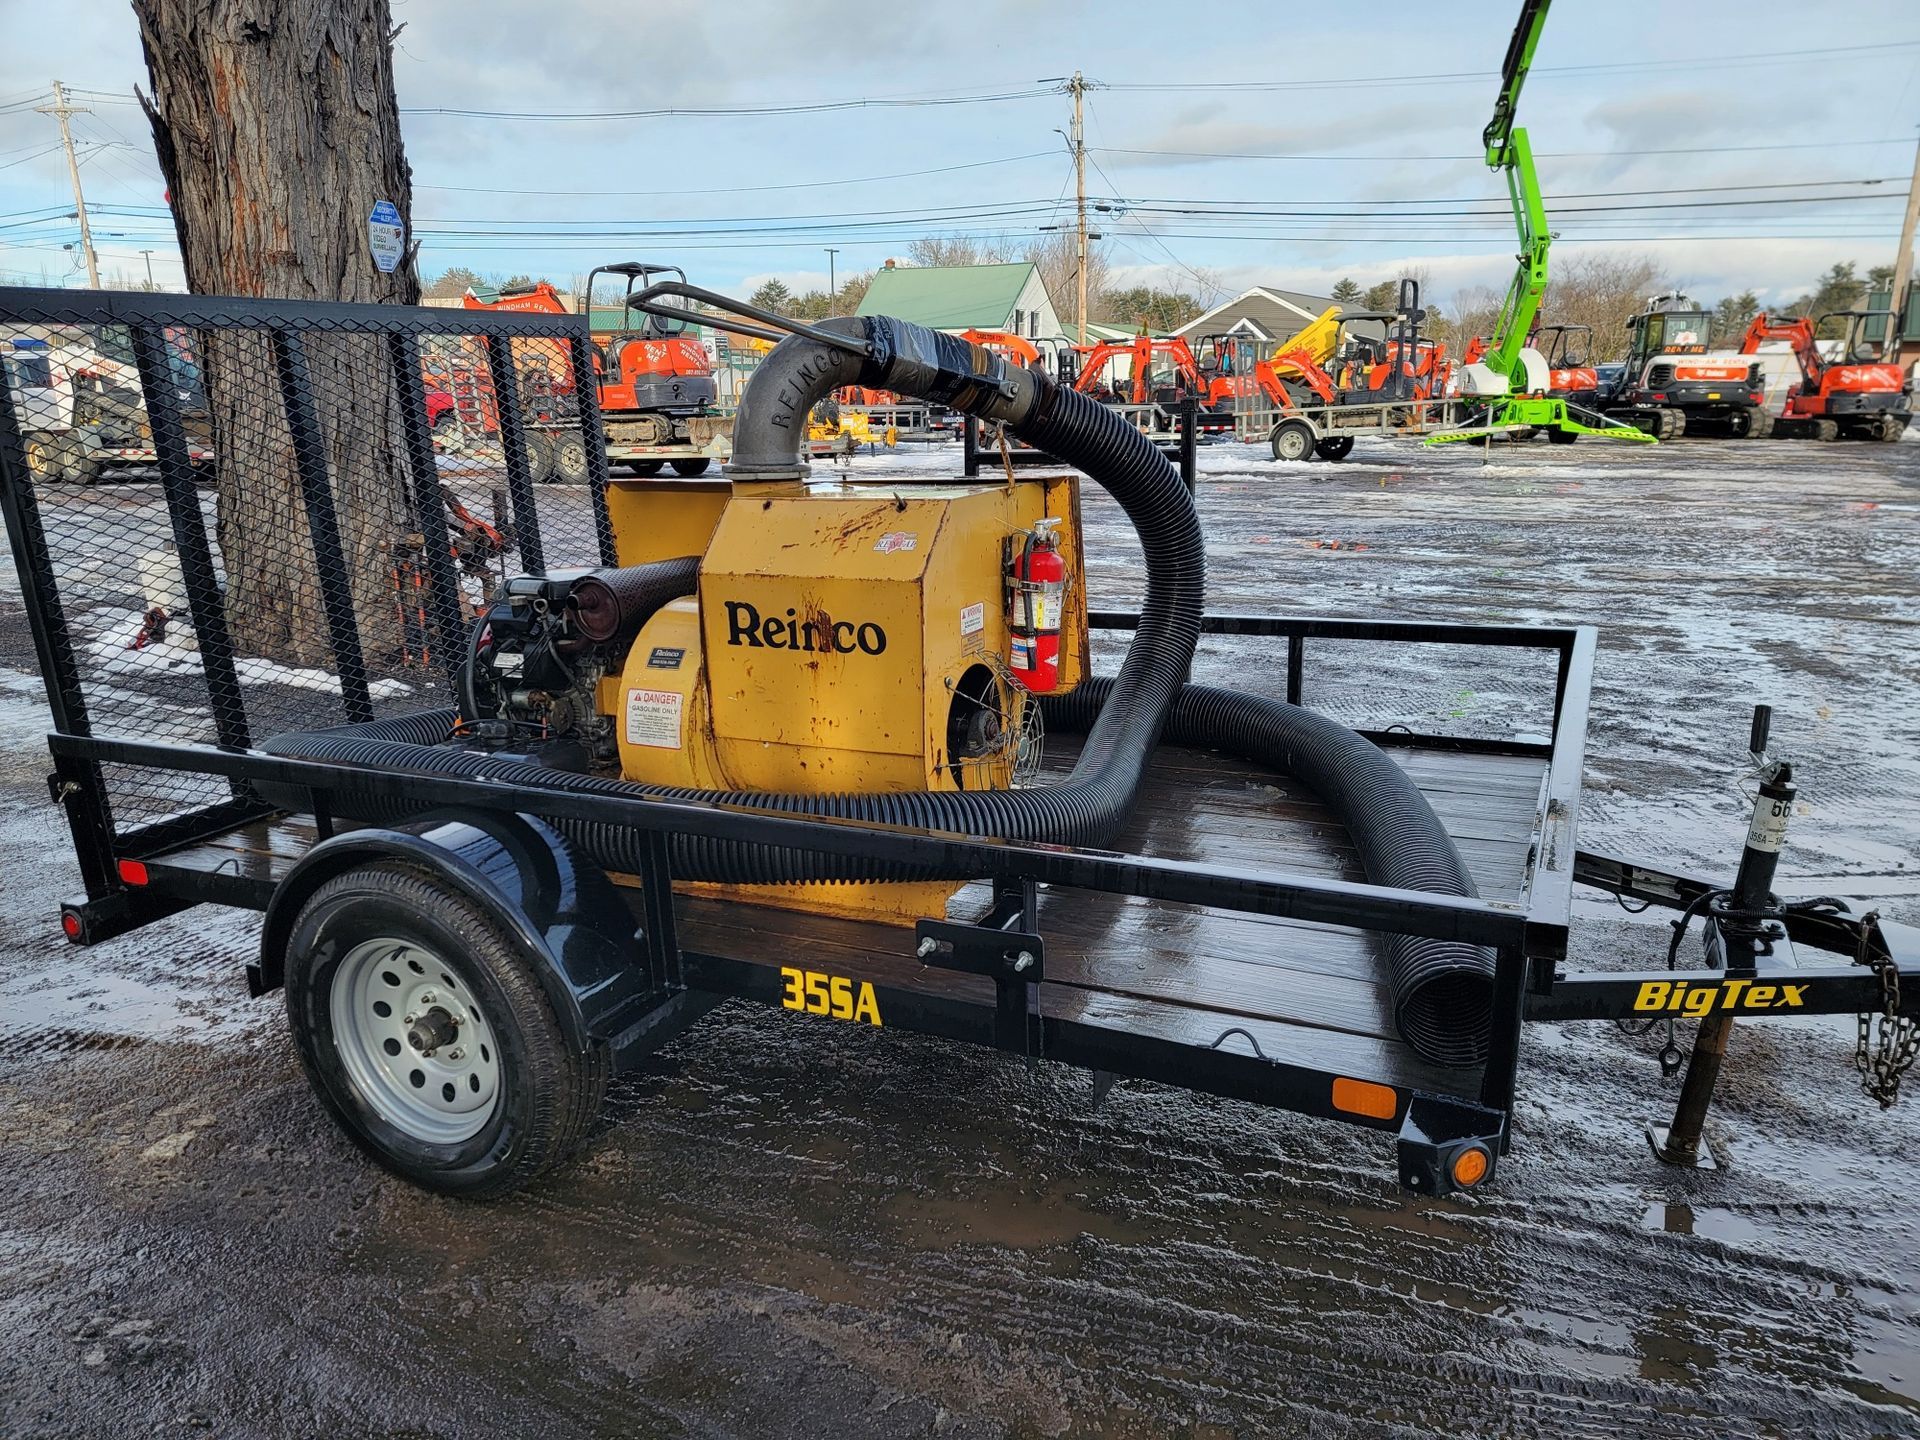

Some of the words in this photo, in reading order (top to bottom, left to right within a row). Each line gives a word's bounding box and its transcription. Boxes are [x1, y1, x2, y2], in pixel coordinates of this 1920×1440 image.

[373, 234, 387, 243] VIDEO
[497, 302, 531, 311] WINDHAM
[644, 343, 667, 358] RENT
[1690, 345, 1705, 353] ME
[646, 353, 659, 363] ME
[771, 347, 842, 429] REINCO
[724, 600, 887, 656] Reinco
[655, 649, 680, 658] Reinco
[643, 692, 677, 705] DANGER
[631, 704, 660, 714] GASOLINE
[661, 707, 678, 715] ONLY
[781, 966, 882, 1026] 35SA
